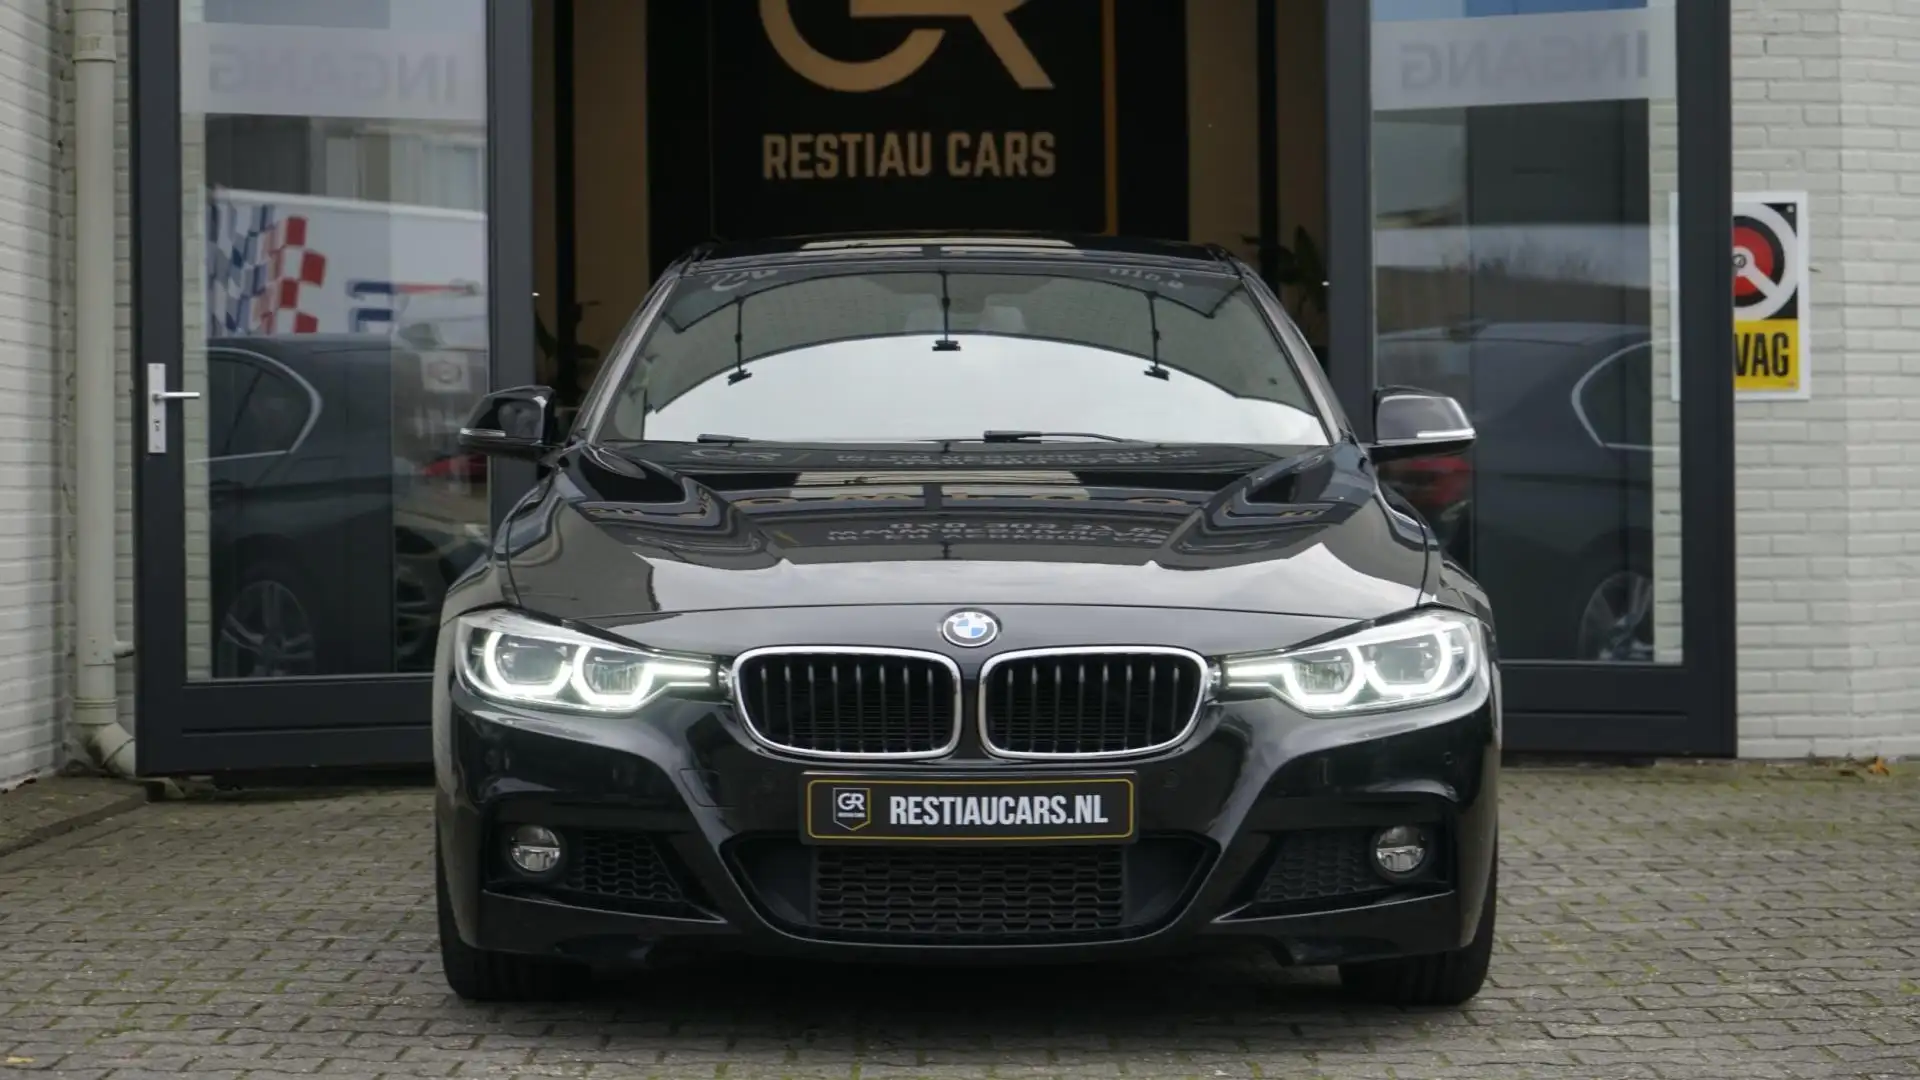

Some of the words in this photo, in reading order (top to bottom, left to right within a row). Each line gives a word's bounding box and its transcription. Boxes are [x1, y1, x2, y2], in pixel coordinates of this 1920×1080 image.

[762, 132, 932, 179] RESTIAU
[947, 131, 1056, 178] CARS
[1733, 332, 1789, 376] VAG
[890, 795, 1109, 825] RESTIAUCARS.NL
